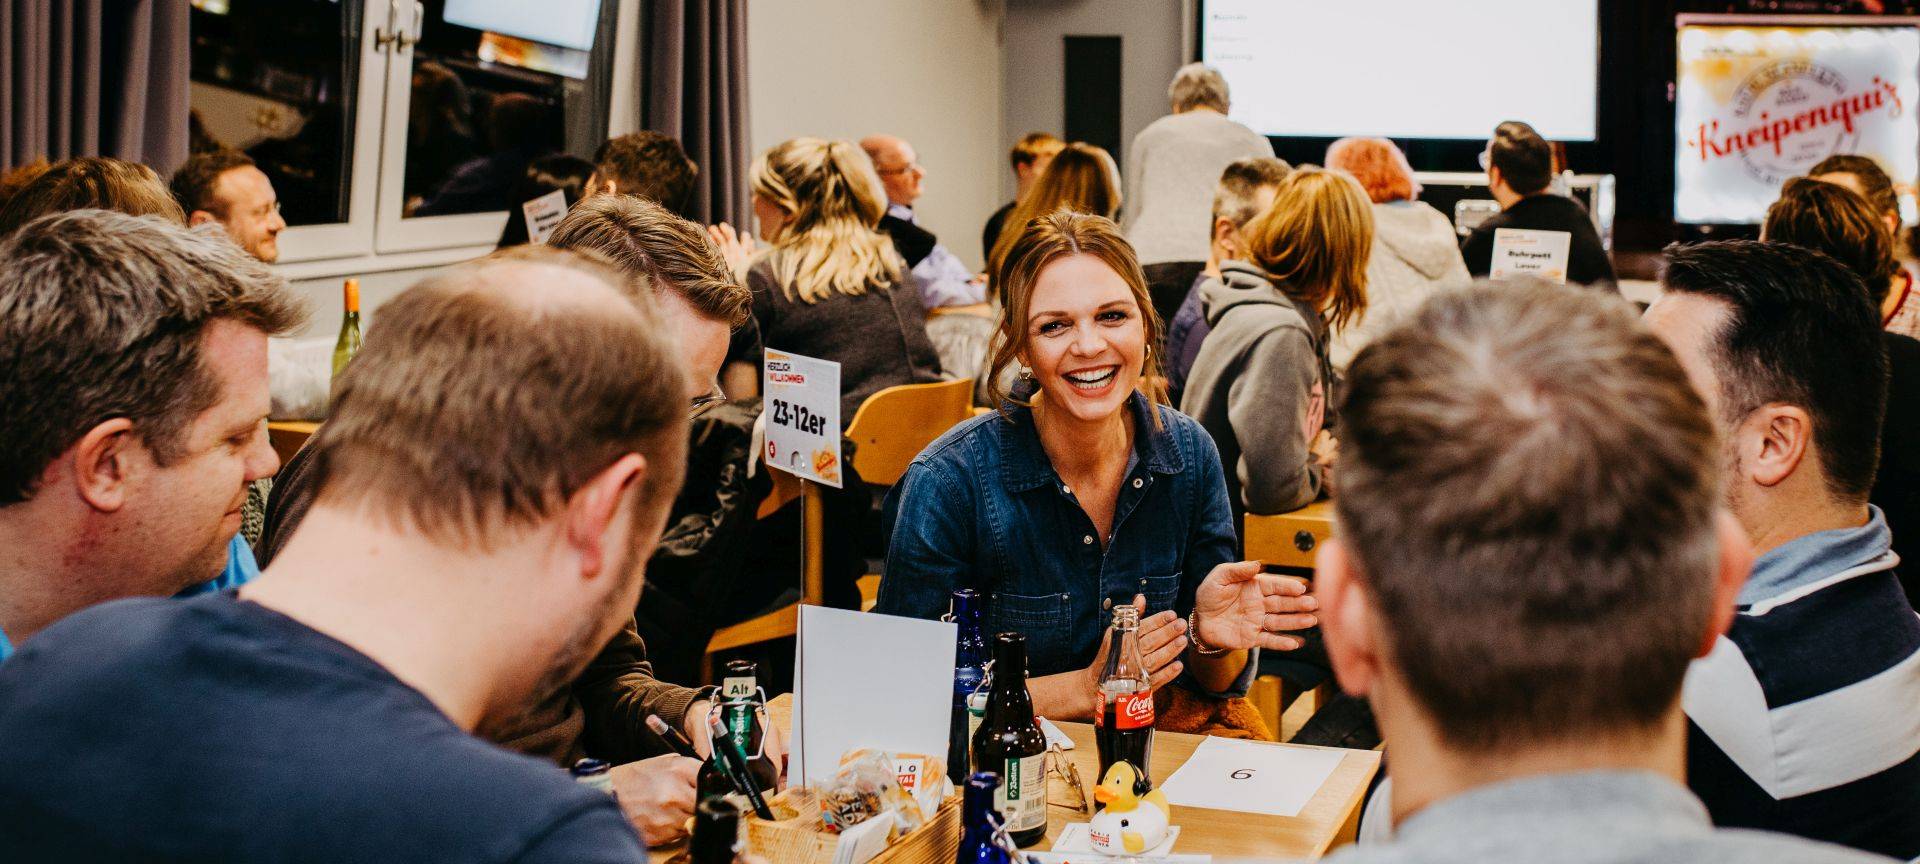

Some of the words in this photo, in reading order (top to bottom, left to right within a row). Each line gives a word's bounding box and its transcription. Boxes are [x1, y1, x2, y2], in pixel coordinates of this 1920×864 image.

[1688, 75, 1903, 161] Kneipenquiz
[773, 398, 826, 437] 23-12er
[731, 684, 748, 695] Alt
[1231, 768, 1256, 780] 6
